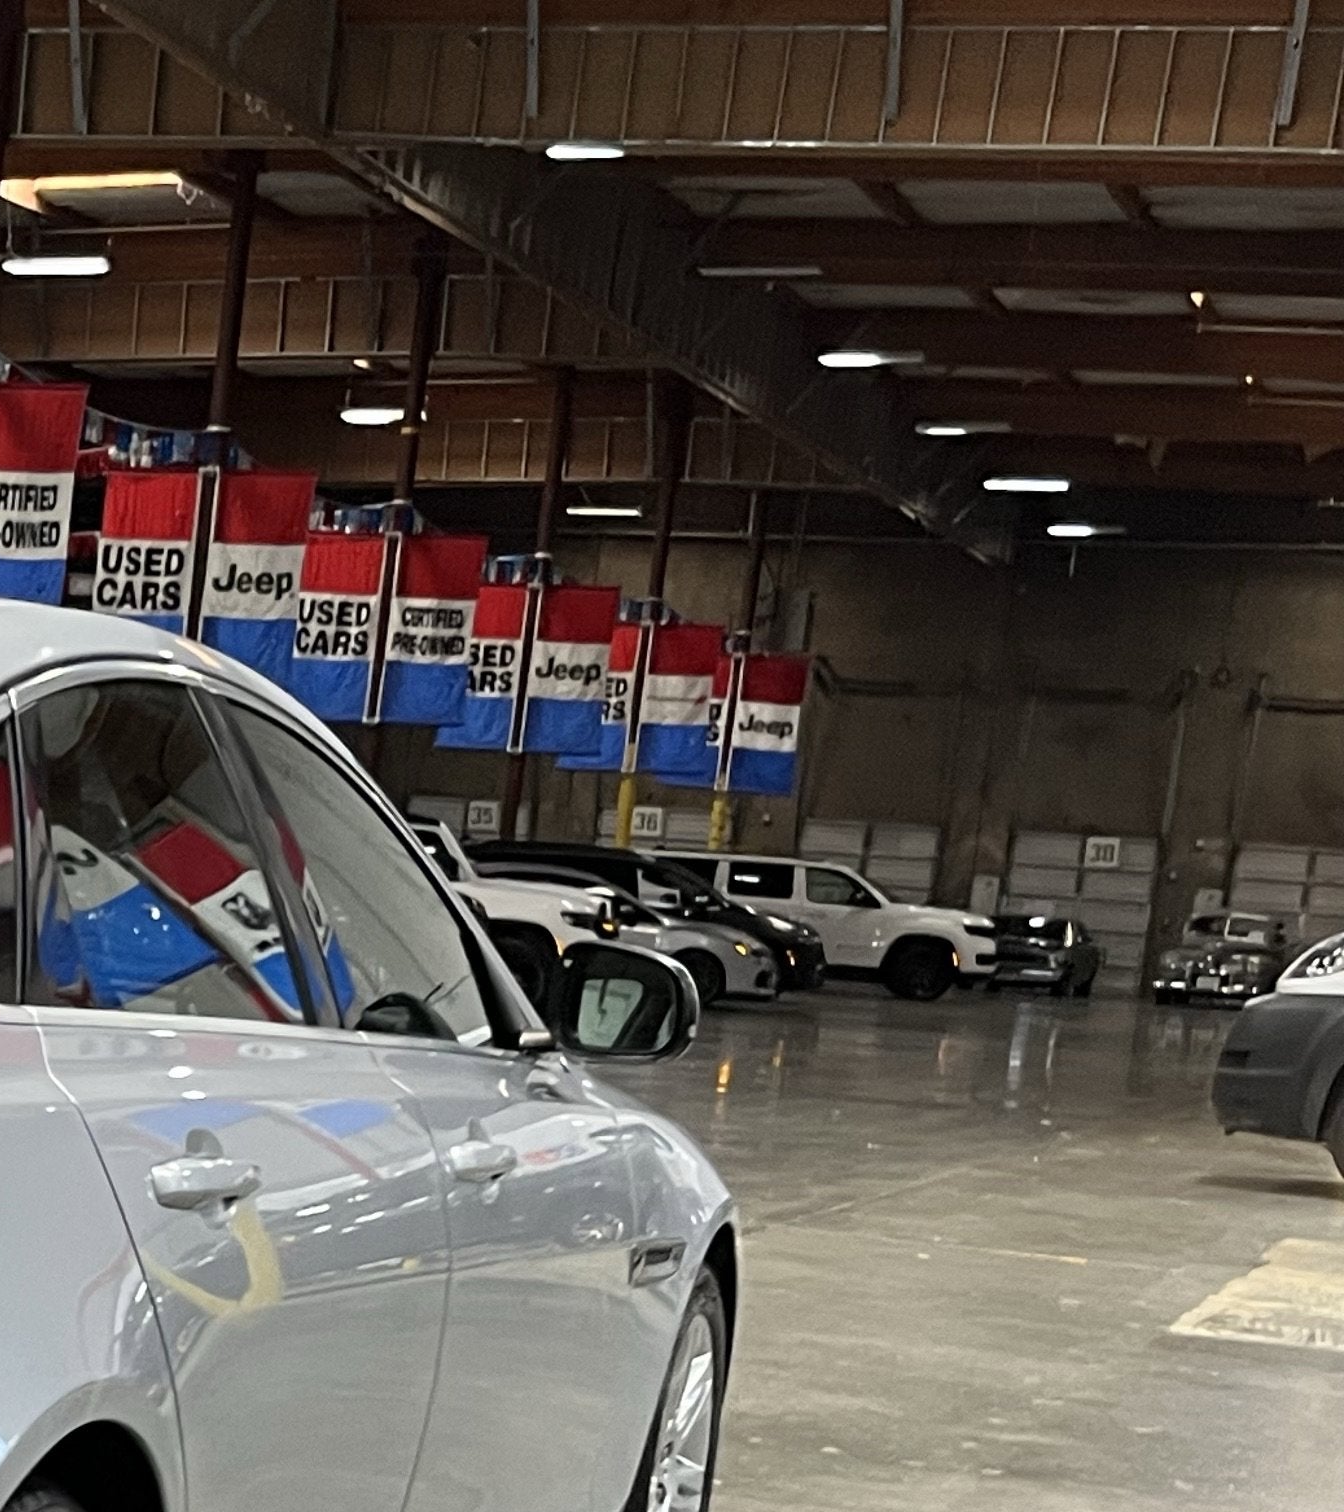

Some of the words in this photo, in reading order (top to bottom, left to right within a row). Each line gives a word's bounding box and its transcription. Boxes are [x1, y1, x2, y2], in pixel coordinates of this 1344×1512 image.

[101, 545, 185, 577] USED
[96, 578, 182, 611] CARS
[212, 563, 294, 601] Jeep
[298, 598, 371, 627] USED
[295, 627, 369, 657] CARS
[468, 643, 516, 668] SED
[467, 670, 513, 693] ARS
[534, 656, 602, 686] Jeep
[738, 714, 794, 740] Jeep
[471, 806, 493, 825] 35
